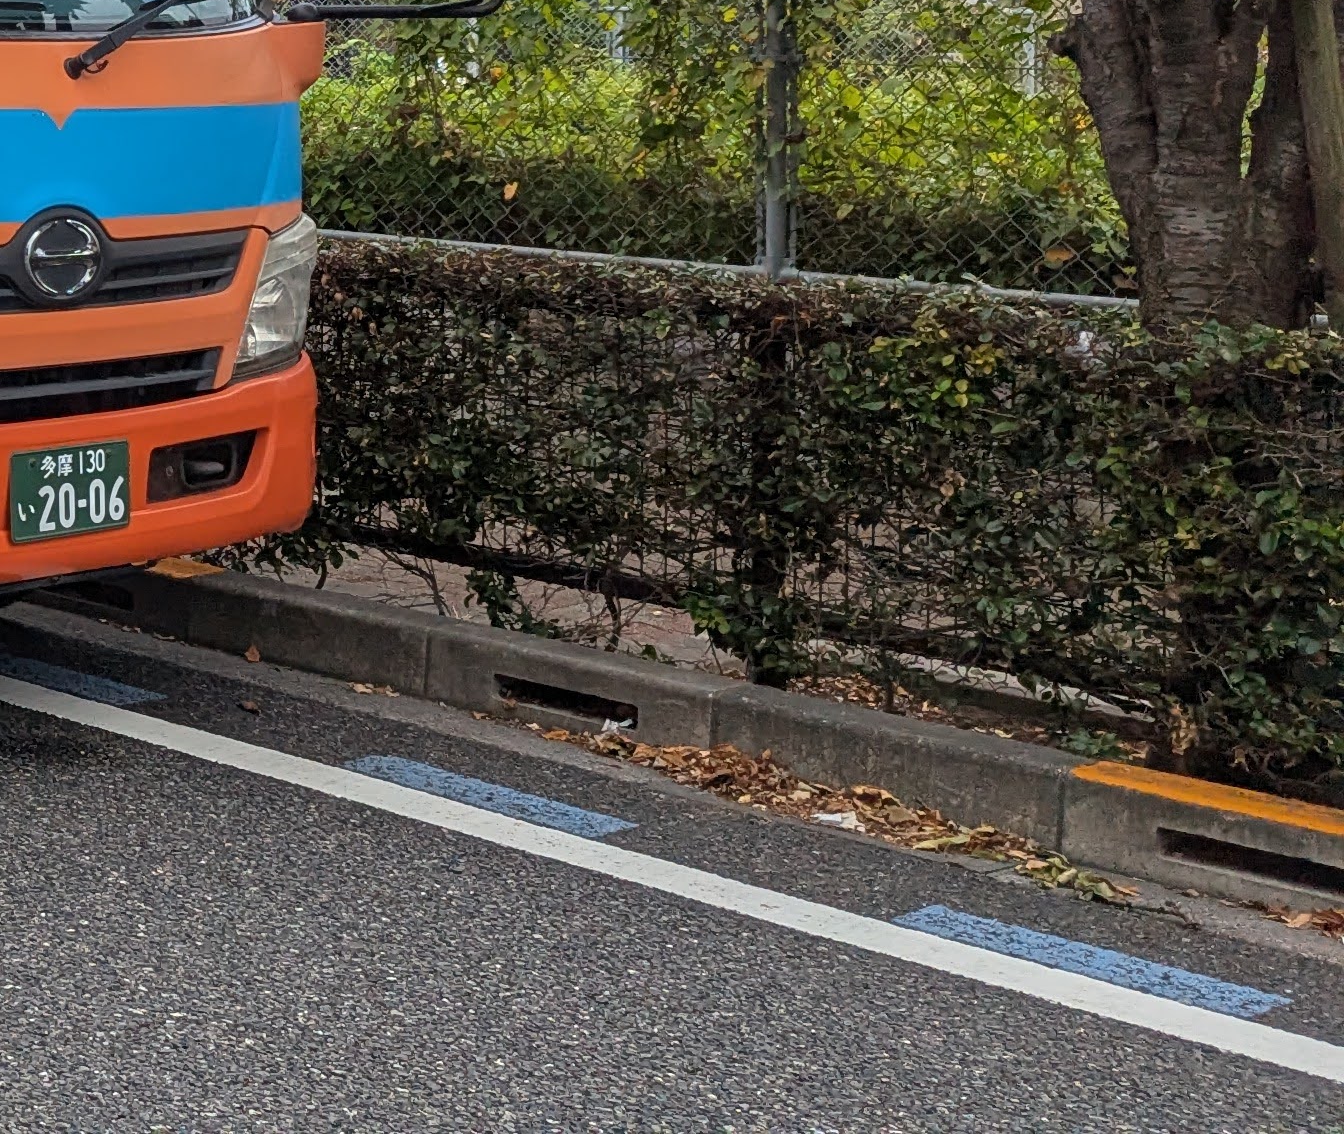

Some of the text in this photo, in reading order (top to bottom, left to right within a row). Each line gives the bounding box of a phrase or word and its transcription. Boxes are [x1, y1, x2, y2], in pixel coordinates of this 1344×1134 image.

[40, 448, 106, 479] 多摩 130
[17, 475, 125, 533] い 20-06
